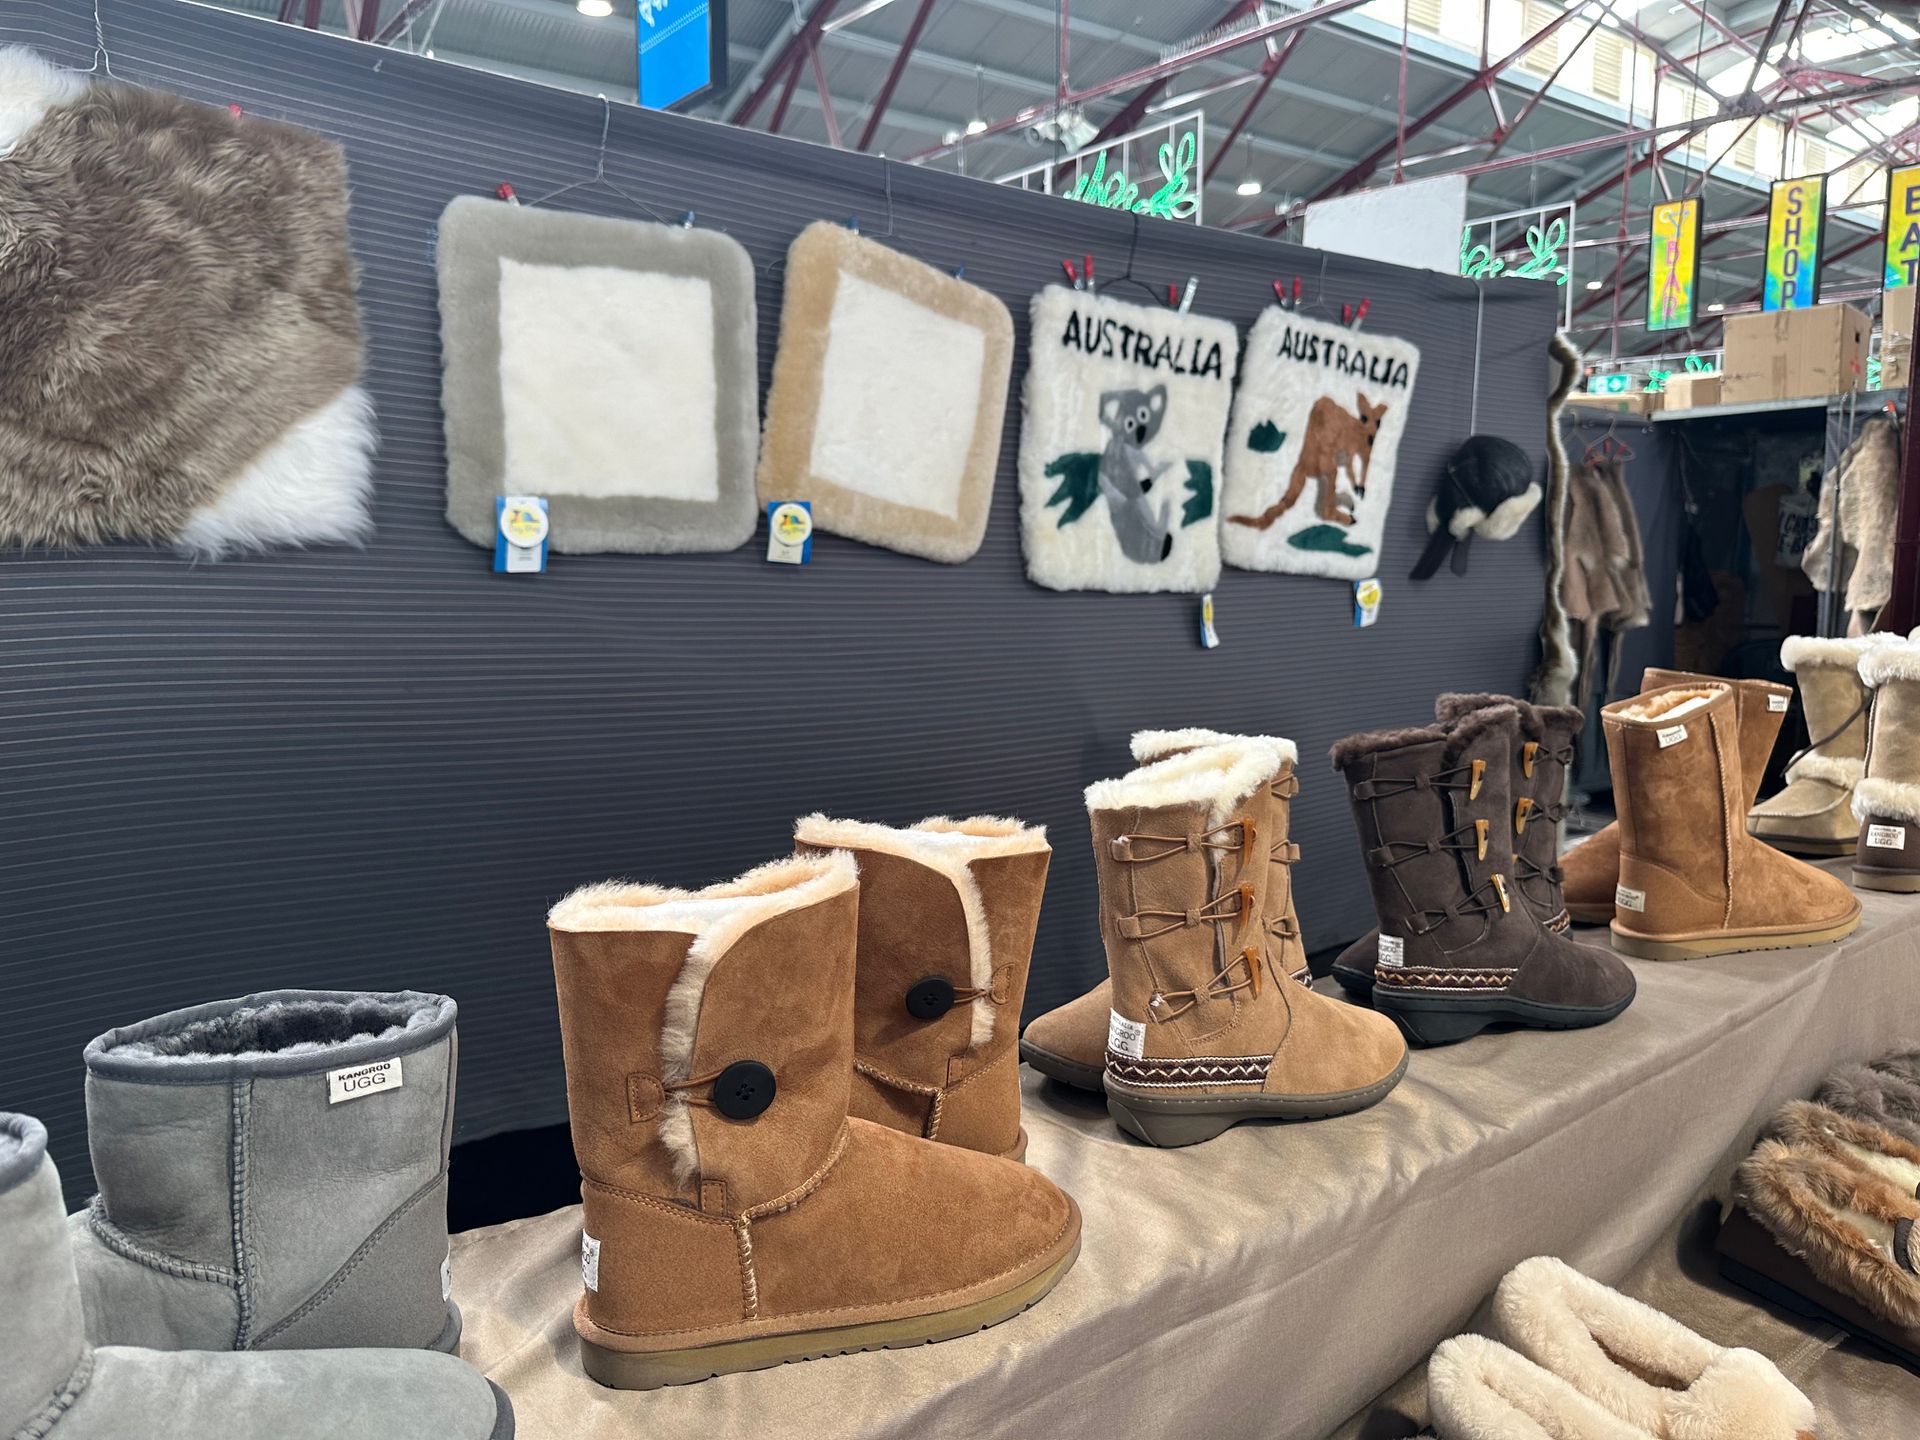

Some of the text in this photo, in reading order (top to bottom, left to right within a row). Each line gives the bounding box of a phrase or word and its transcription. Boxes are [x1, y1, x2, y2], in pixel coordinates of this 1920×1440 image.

[1662, 240, 1681, 321] BAR
[1780, 186, 1803, 311] SHOP
[1062, 310, 1222, 381] AUSTRALIA
[1277, 326, 1410, 390] AUSTRALIA
[338, 1062, 391, 1081] KANGROO
[344, 1072, 386, 1092] UGG
